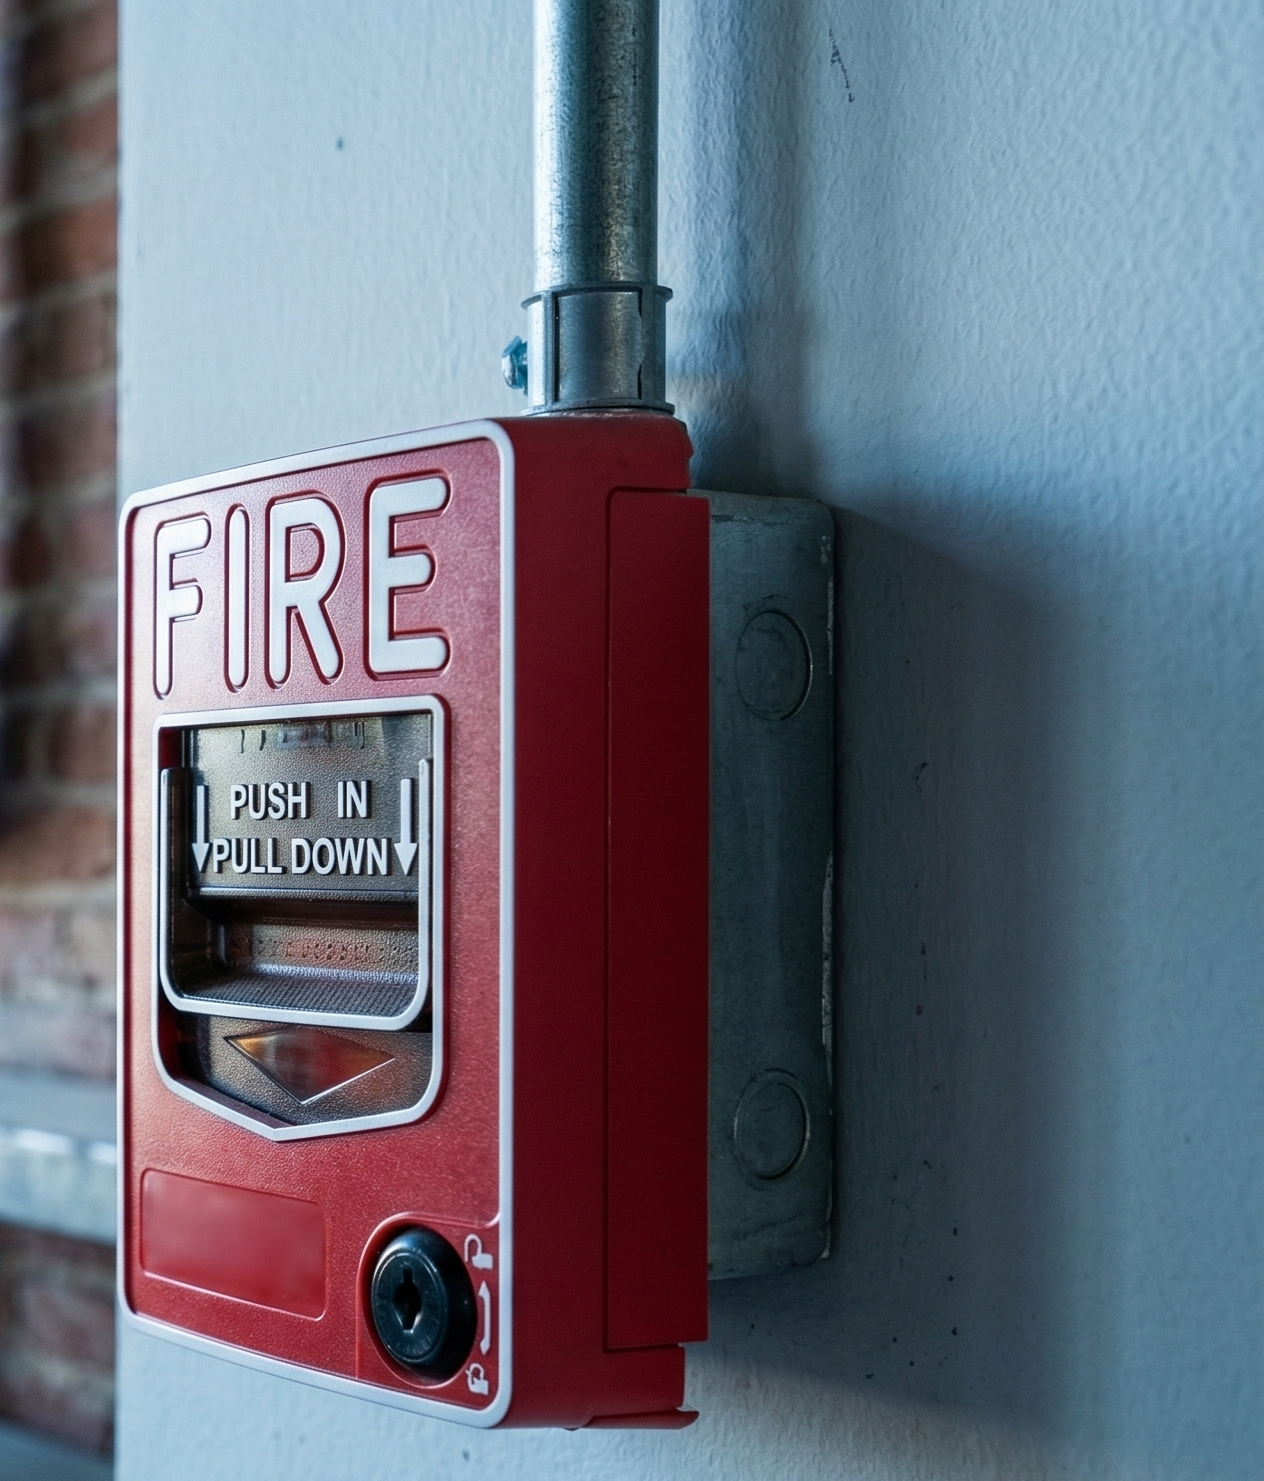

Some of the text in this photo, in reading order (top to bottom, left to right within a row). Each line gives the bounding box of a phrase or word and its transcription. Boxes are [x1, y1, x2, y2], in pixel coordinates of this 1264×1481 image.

[153, 474, 450, 698] FIRE
[230, 780, 368, 820] PUSH IN
[212, 837, 388, 876] PULL DOWN
